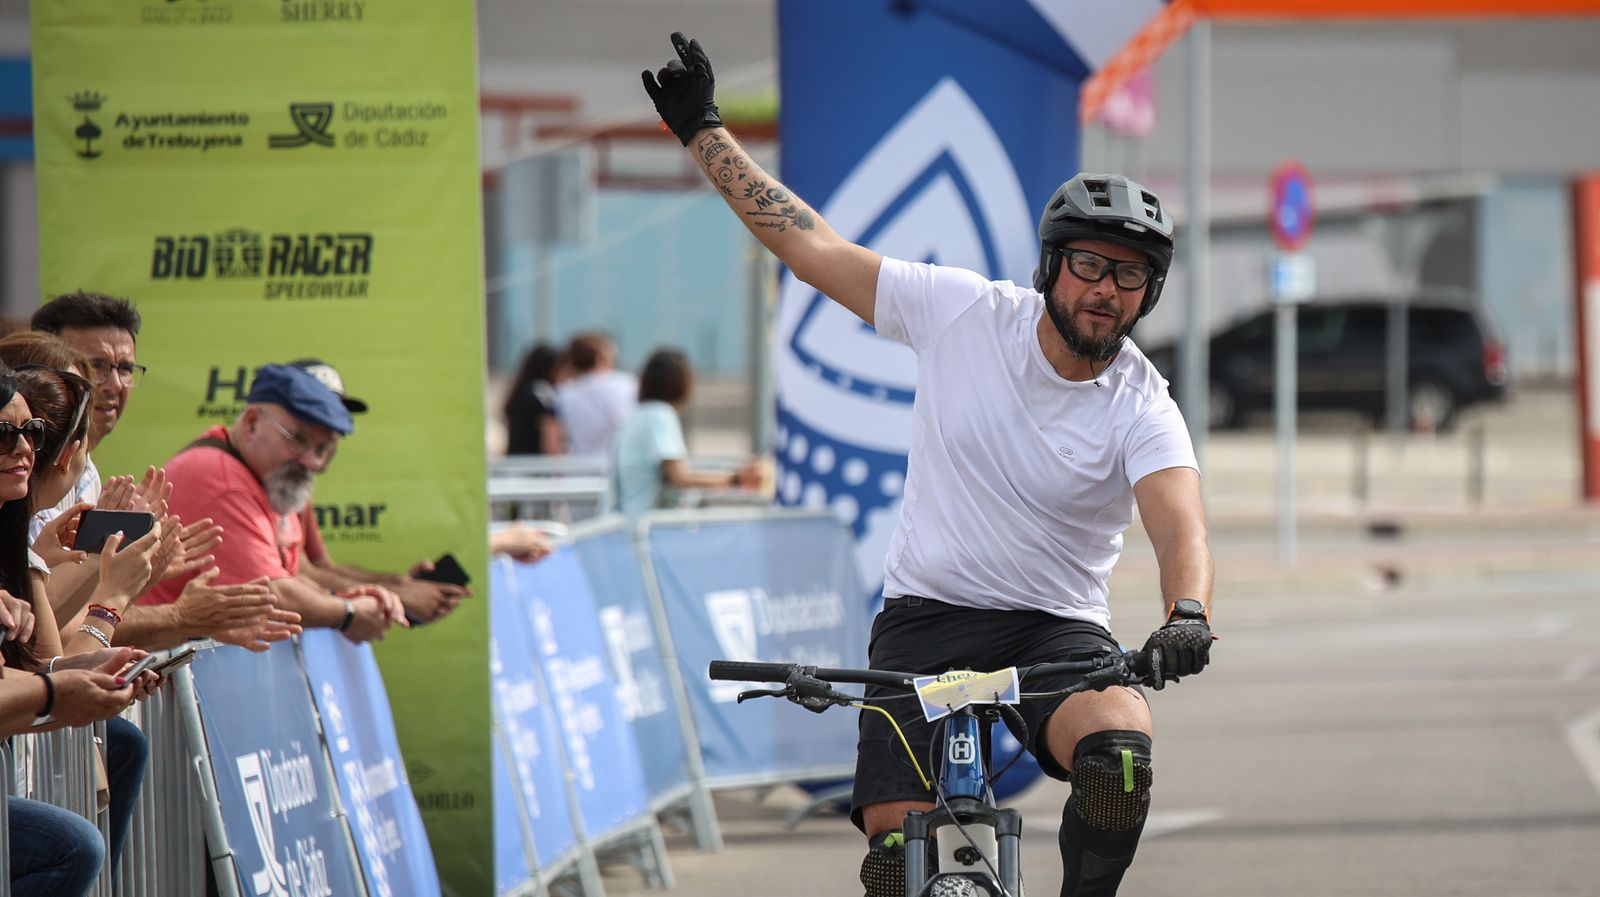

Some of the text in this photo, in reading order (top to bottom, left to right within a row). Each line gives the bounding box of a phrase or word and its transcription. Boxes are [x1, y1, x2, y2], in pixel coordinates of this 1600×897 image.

[115, 112, 250, 130] Ayuntamiento
[344, 130, 368, 147] de
[267, 232, 373, 277] RACER
[265, 279, 369, 299] SPEEDWEAR
